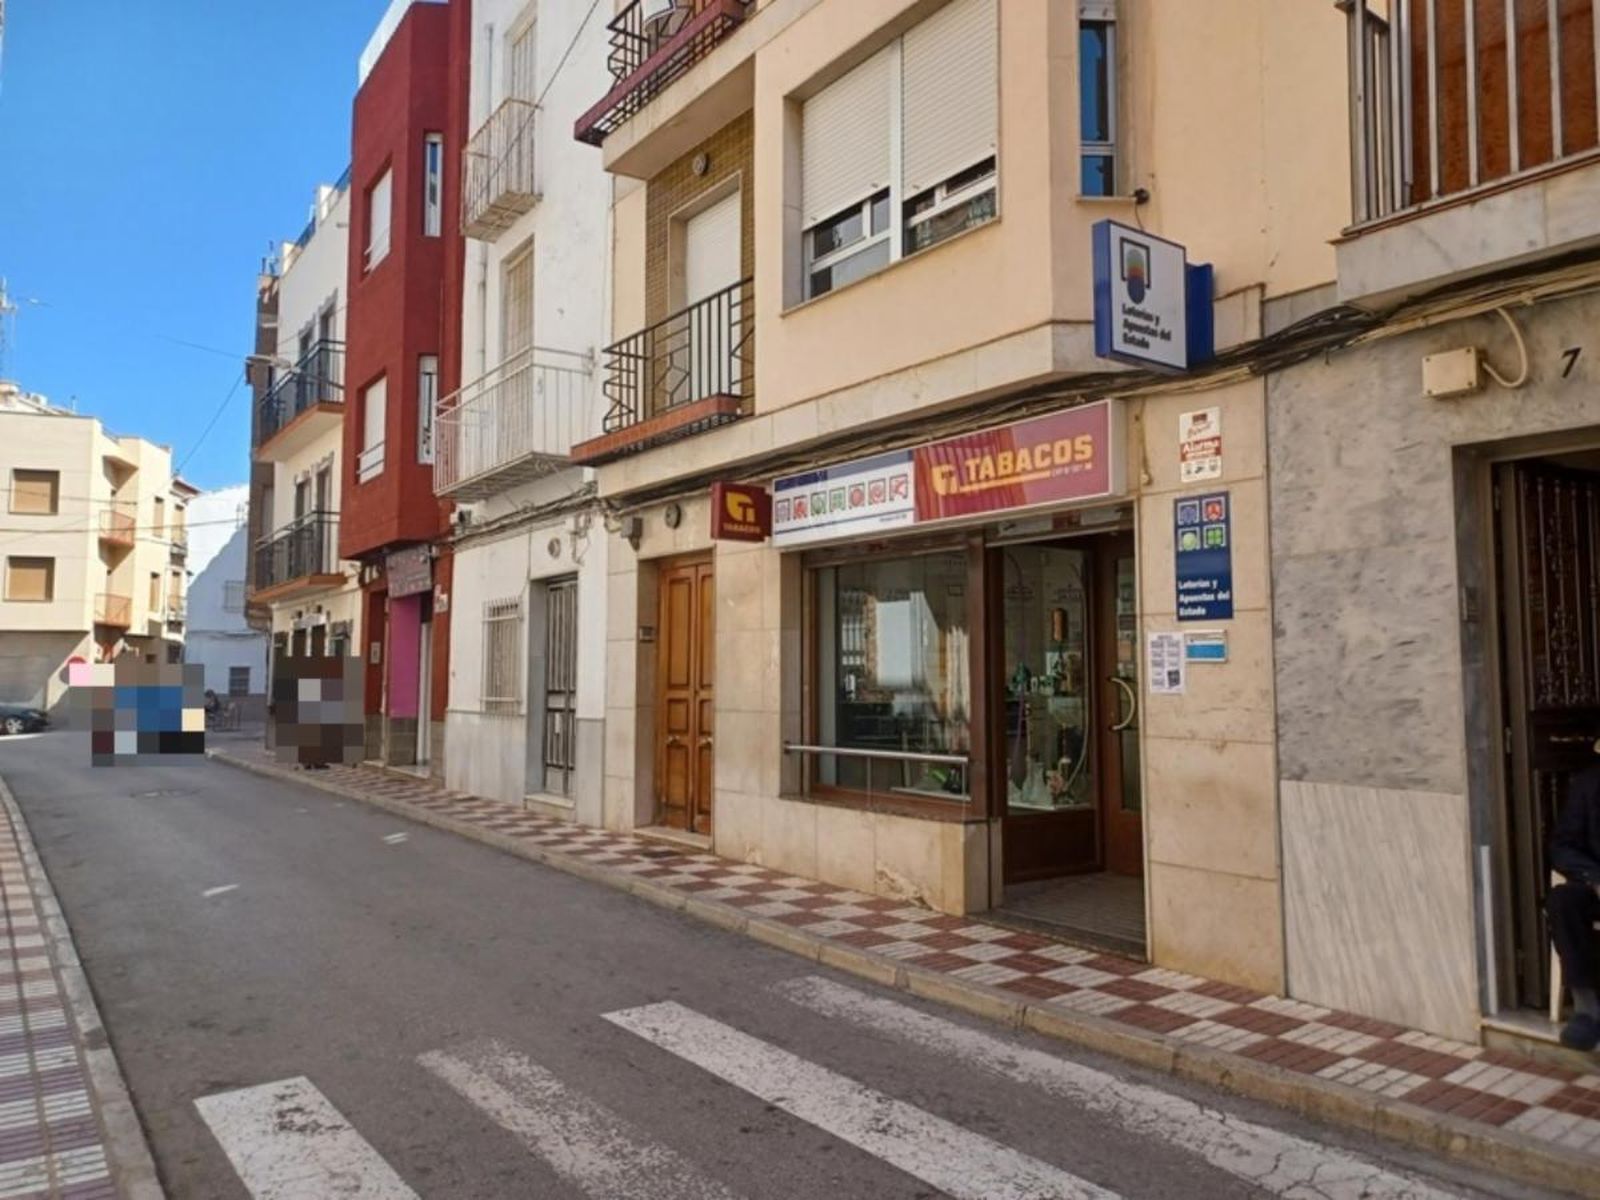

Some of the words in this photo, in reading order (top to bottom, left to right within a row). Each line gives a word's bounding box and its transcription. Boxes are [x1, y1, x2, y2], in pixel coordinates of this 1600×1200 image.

[1561, 346, 1582, 379] 7
[965, 434, 1093, 482] TABACOS
[1217, 590, 1230, 601] del
